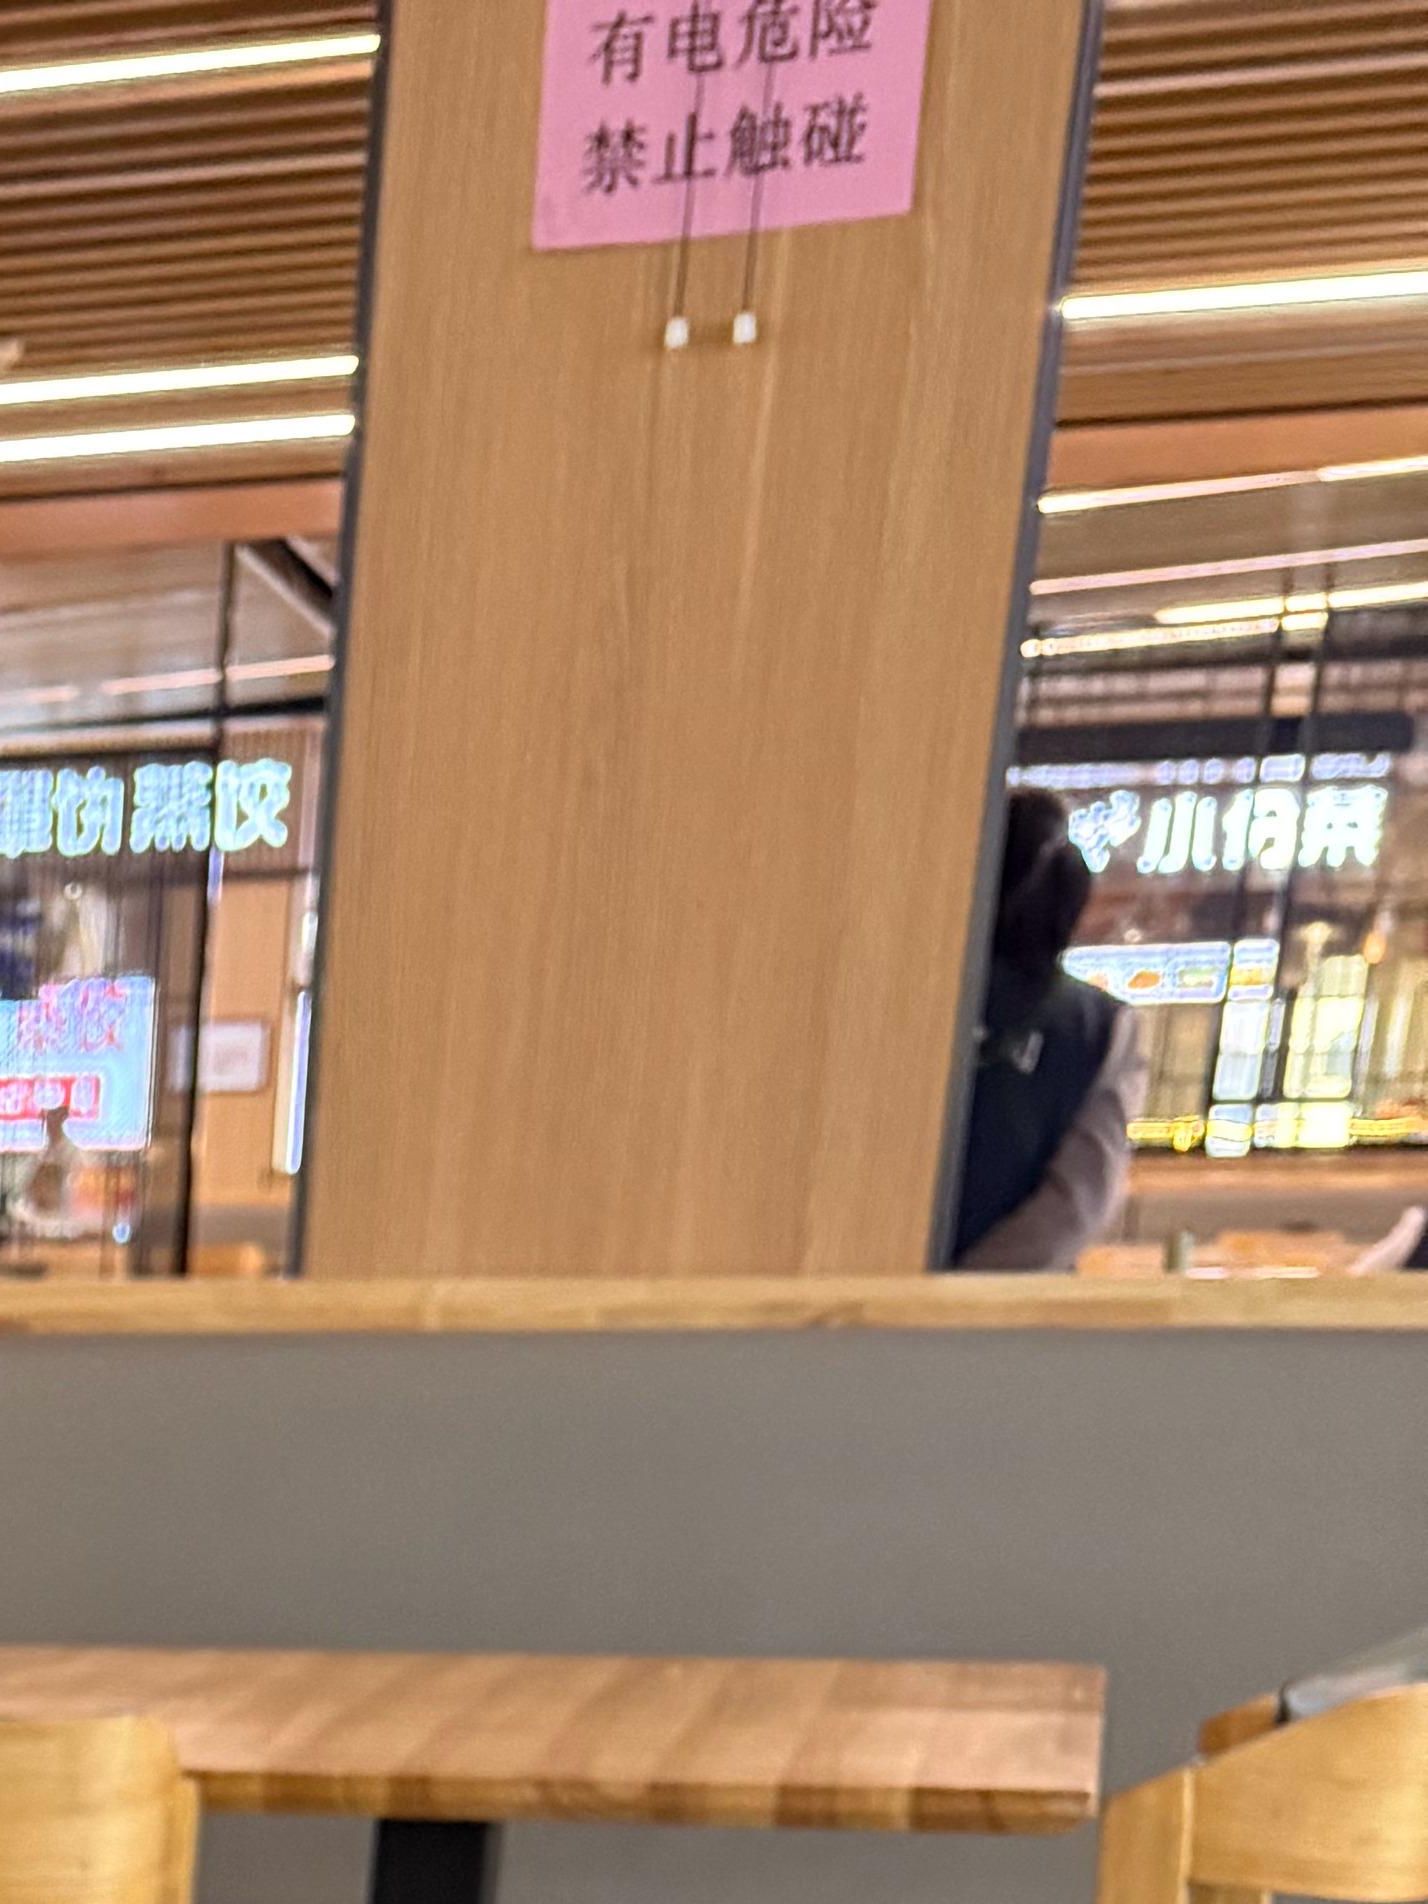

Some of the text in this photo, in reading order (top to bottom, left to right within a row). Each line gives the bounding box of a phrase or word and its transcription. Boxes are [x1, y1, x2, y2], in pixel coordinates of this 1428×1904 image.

[589, 0, 876, 86] 有电危险
[583, 92, 869, 195] 禁止触碰
